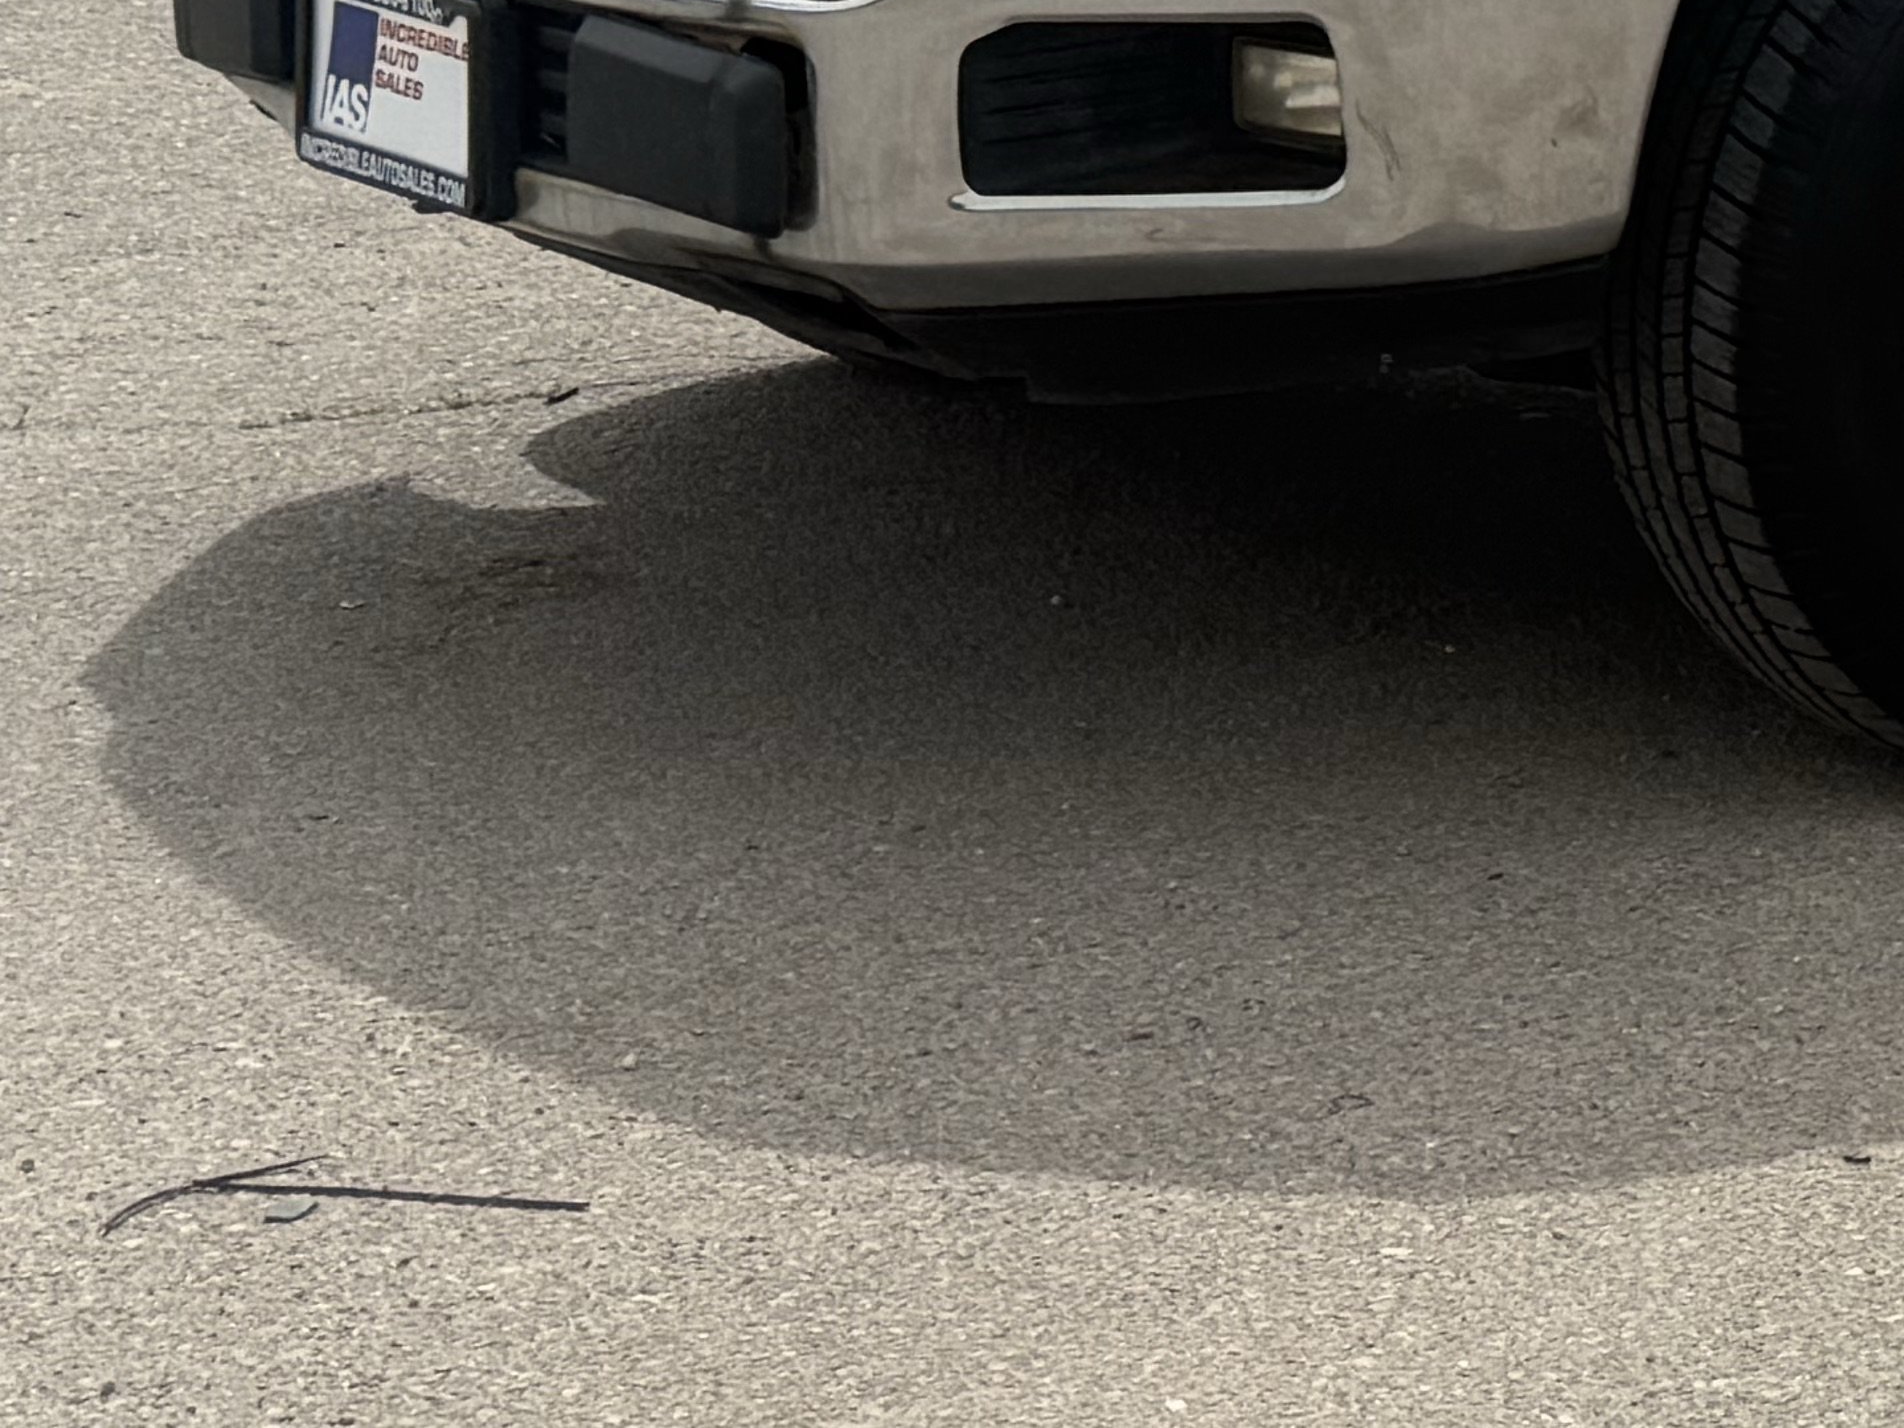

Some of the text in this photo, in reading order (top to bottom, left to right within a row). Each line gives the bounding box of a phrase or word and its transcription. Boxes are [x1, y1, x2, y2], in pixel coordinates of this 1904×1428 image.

[378, 44, 419, 73] AUTO
[374, 68, 424, 100] SALES
[321, 74, 369, 132] IAS
